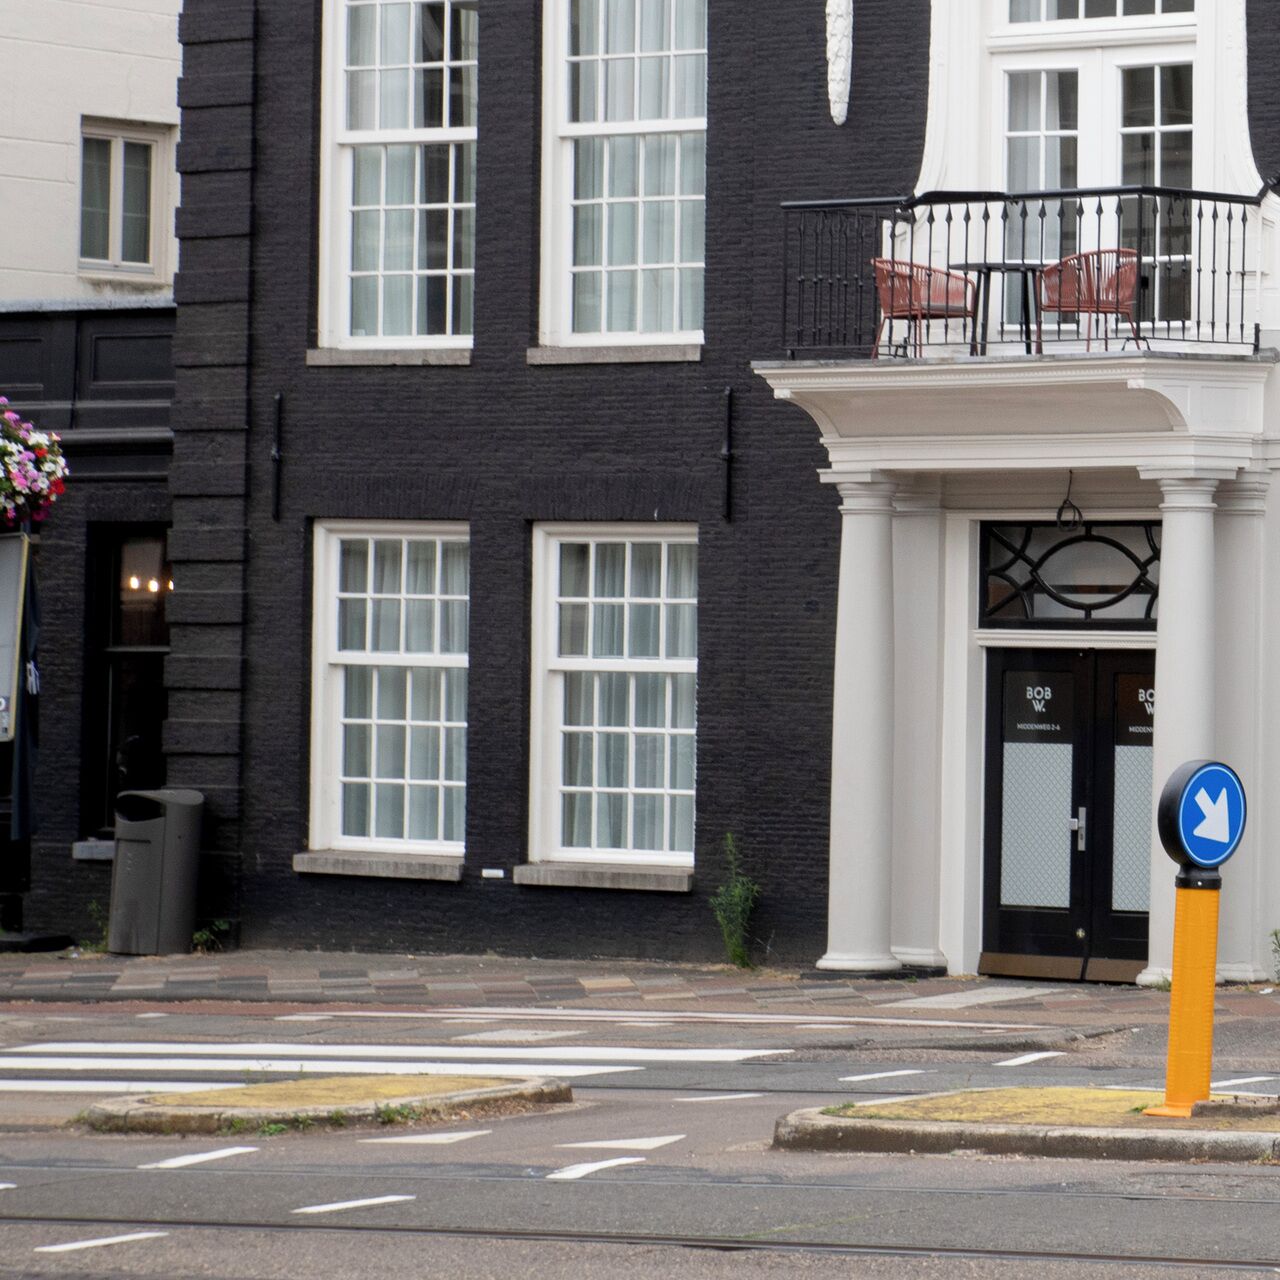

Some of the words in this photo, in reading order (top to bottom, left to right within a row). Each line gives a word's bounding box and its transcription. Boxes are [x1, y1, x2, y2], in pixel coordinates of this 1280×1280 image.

[1026, 686, 1052, 700] BOB
[1138, 688, 1155, 702] BO
[1032, 700, 1046, 712] W.
[1144, 702, 1154, 715] W
[1128, 725, 1153, 733] MIDDEN
